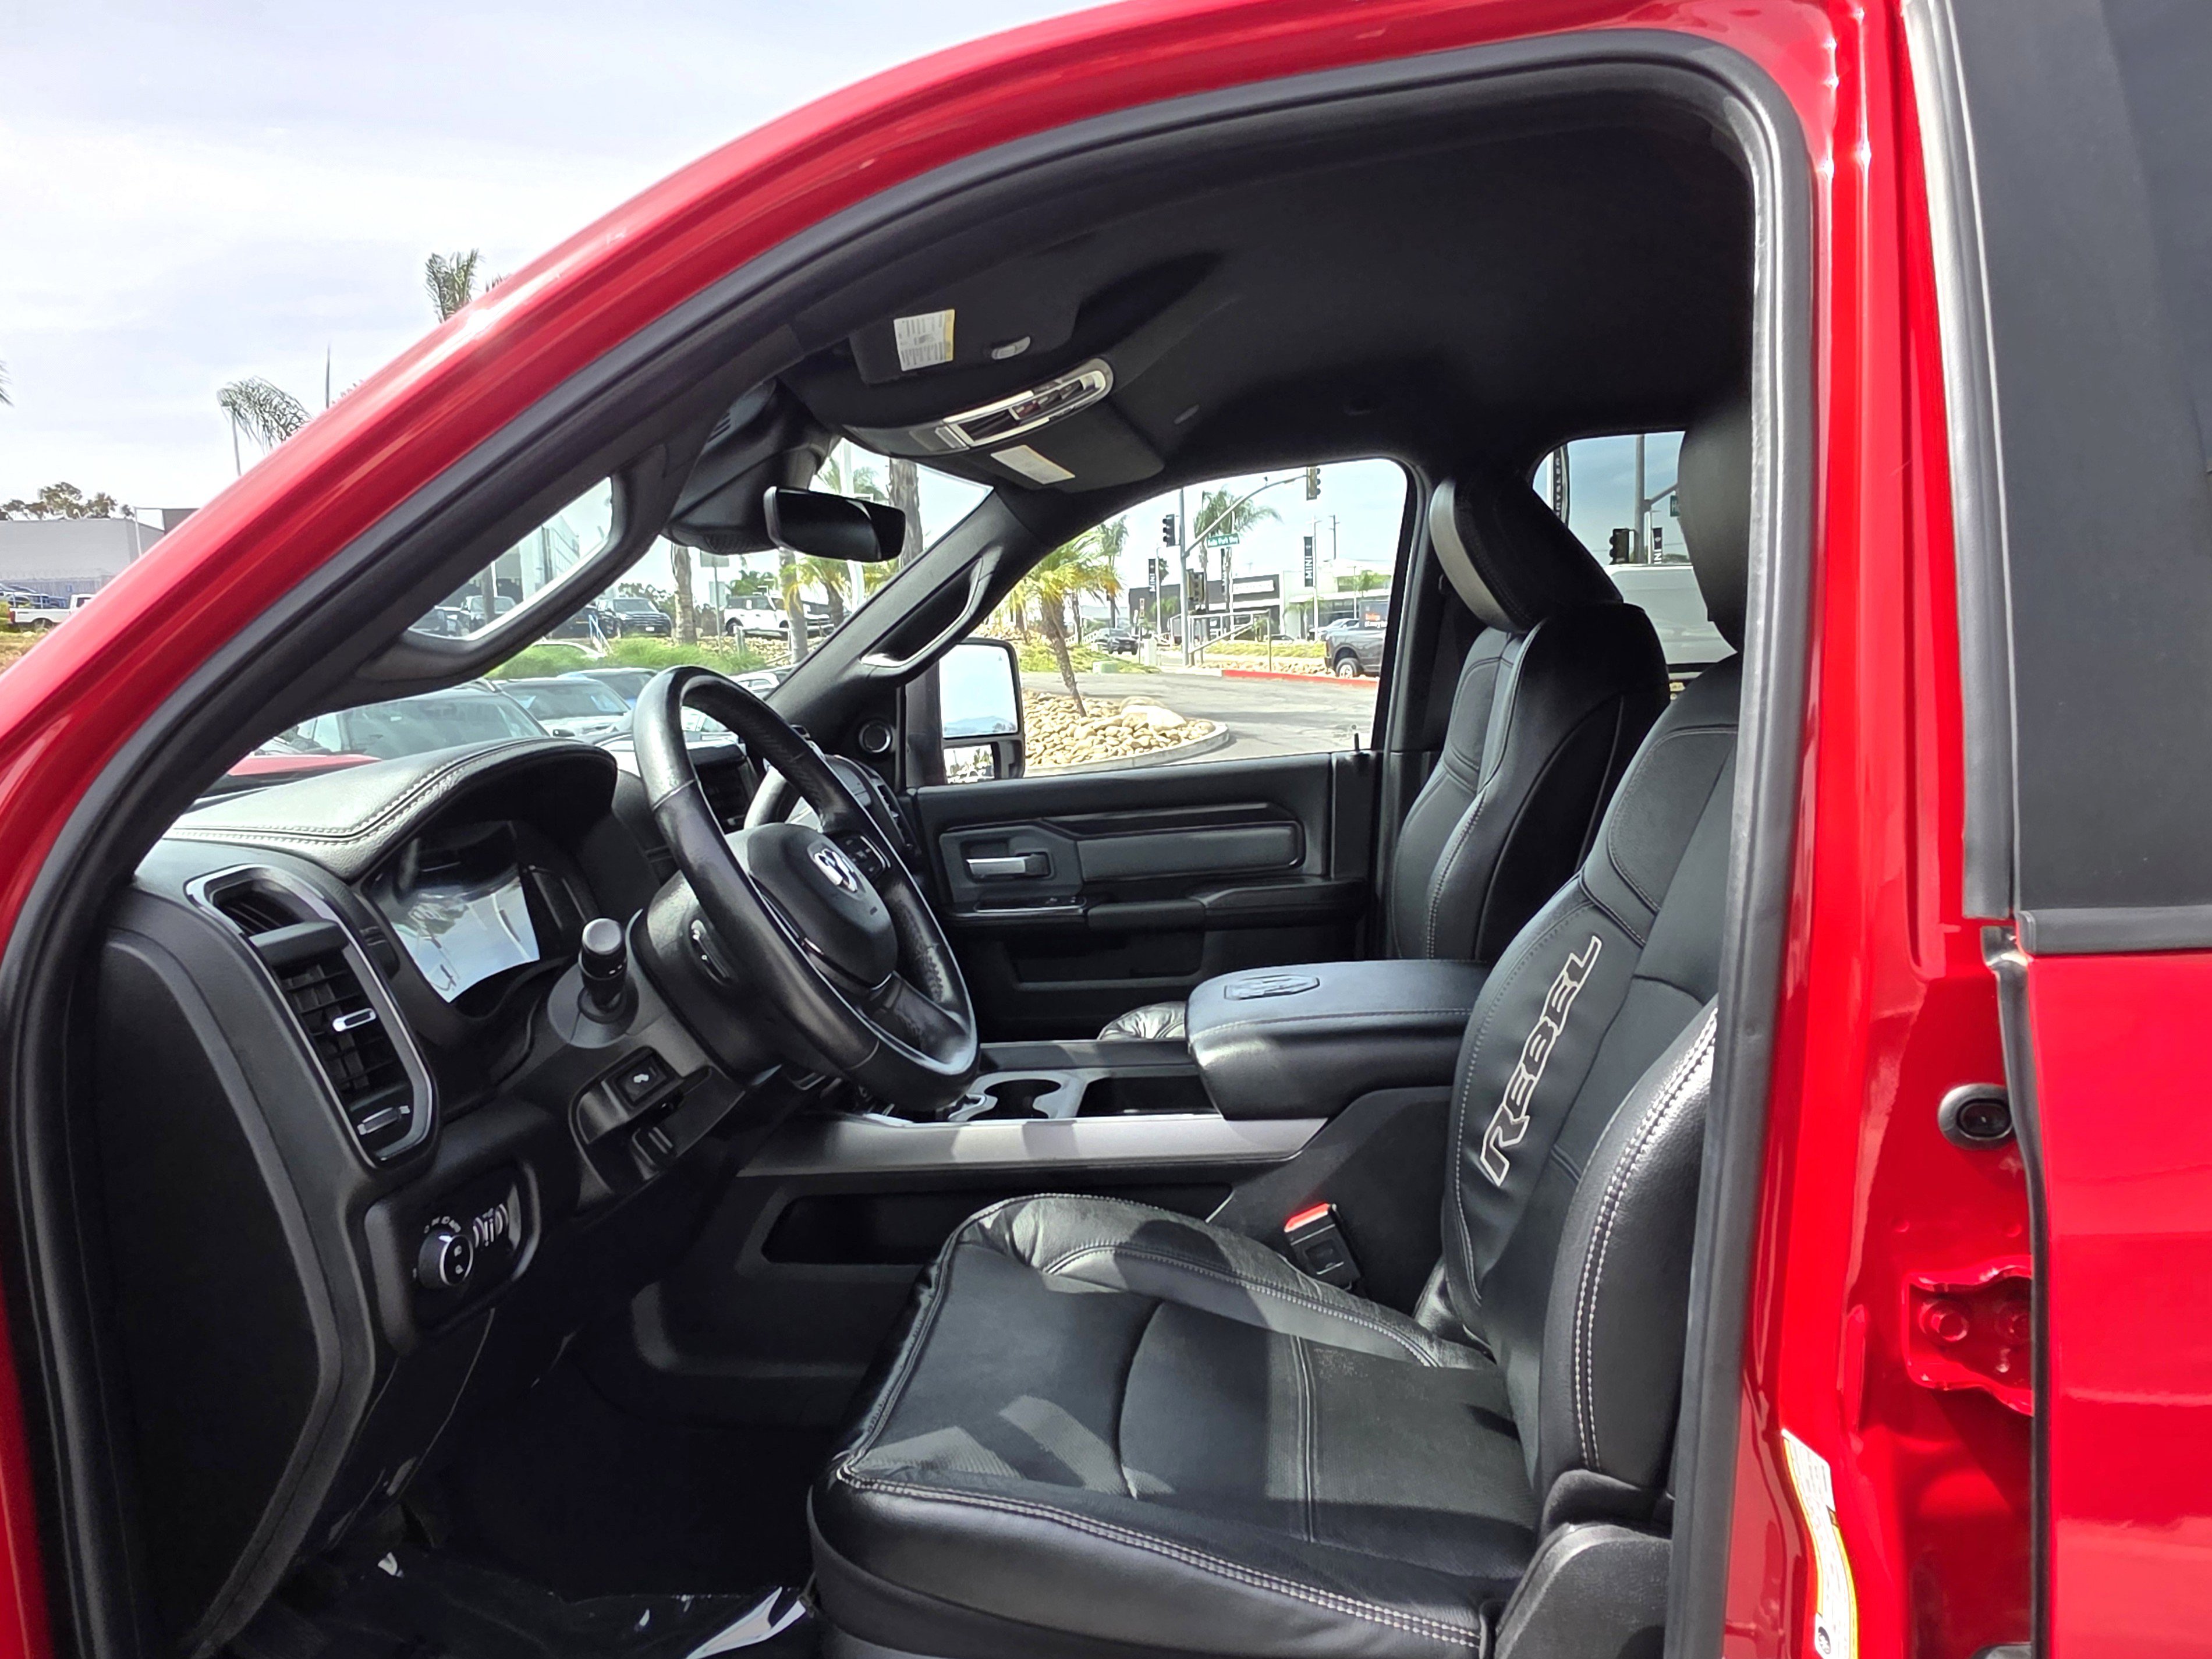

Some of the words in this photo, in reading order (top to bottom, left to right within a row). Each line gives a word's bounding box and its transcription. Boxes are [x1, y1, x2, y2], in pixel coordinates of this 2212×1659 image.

[1304, 555, 1313, 579] MINI
[1654, 549, 1662, 564] INI
[1480, 935, 1603, 1187] REBEL
